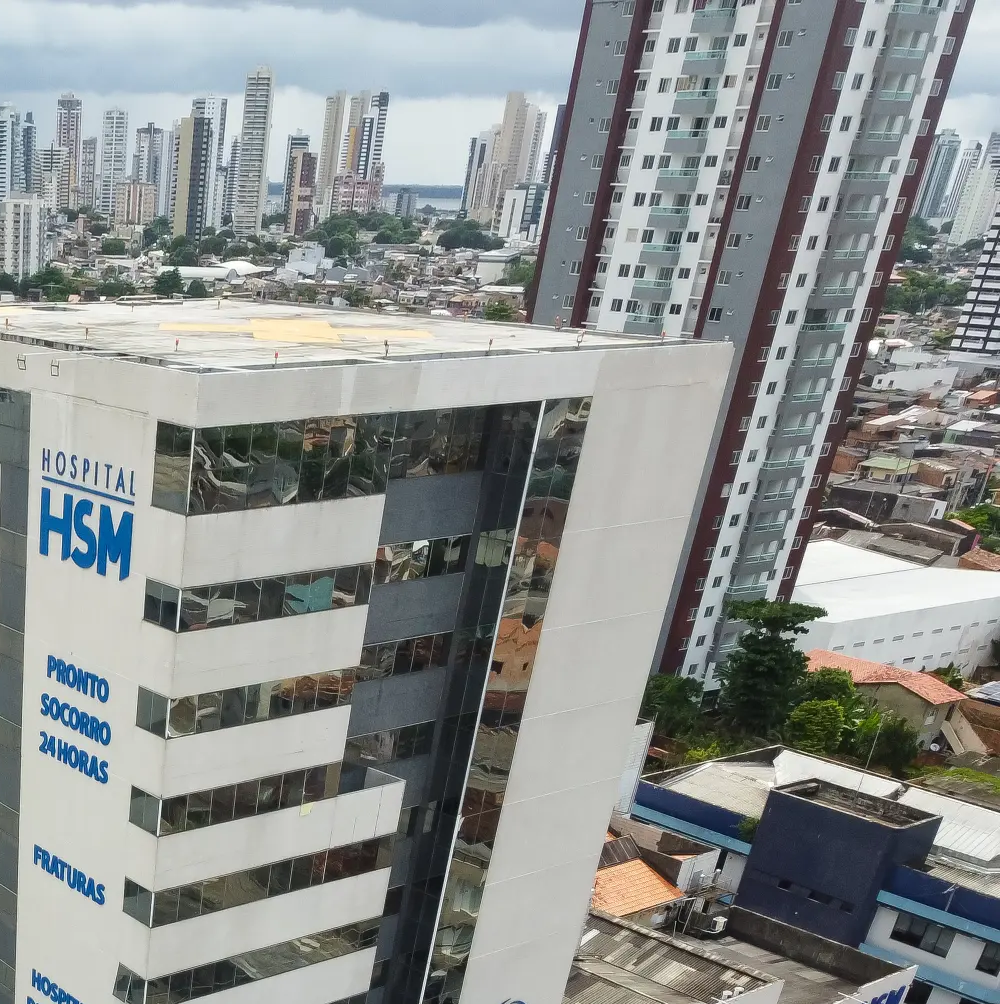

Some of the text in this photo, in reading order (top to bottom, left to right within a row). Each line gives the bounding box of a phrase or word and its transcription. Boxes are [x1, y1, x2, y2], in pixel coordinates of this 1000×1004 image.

[42, 448, 135, 496] HOSPITAL
[39, 487, 134, 581] HSM
[47, 655, 109, 703] PRONTO
[40, 693, 111, 746] SOCORRO
[39, 731, 108, 784] 24 HORAS
[34, 844, 105, 905] FRATURAS
